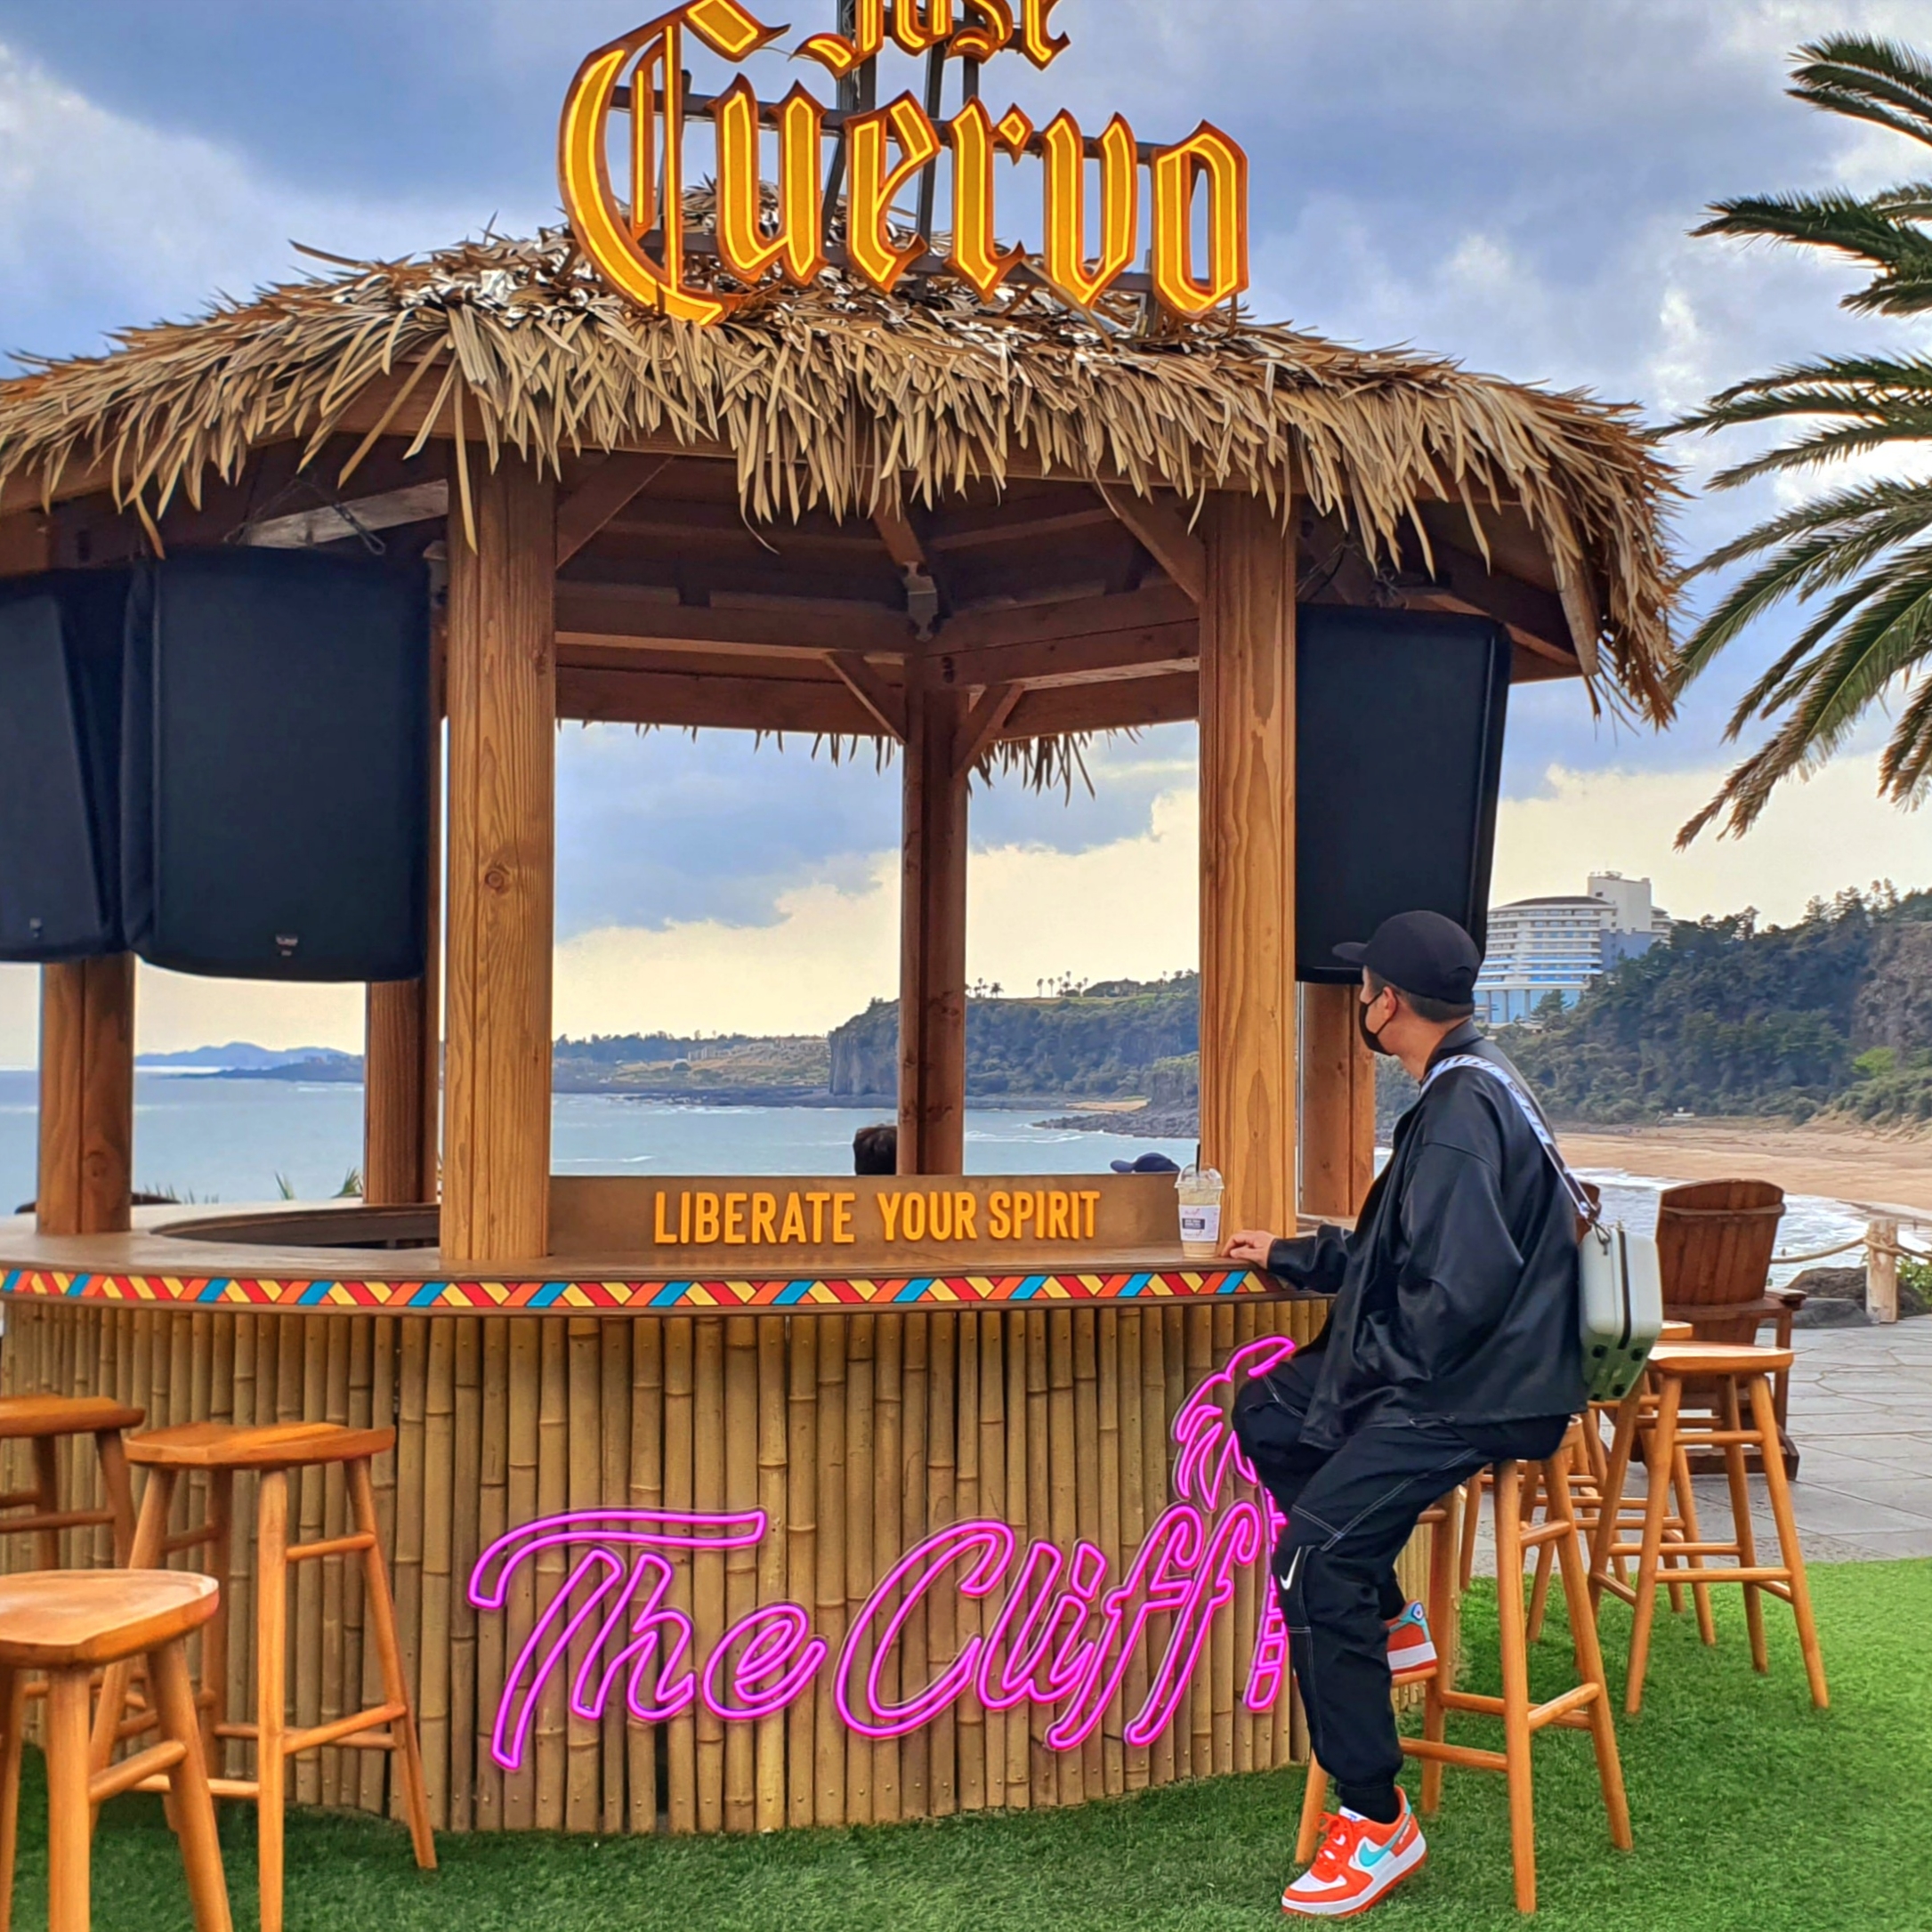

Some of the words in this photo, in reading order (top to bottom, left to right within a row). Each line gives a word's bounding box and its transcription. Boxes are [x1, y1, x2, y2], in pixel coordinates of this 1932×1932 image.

[557, 0, 1249, 326] Cuervo
[653, 1191, 855, 1245] LIBERATE
[877, 1191, 977, 1241] YOUR
[988, 1190, 1101, 1240] SPIRIT
[467, 1508, 828, 1771] The
[834, 1500, 1261, 1750] Cliff
